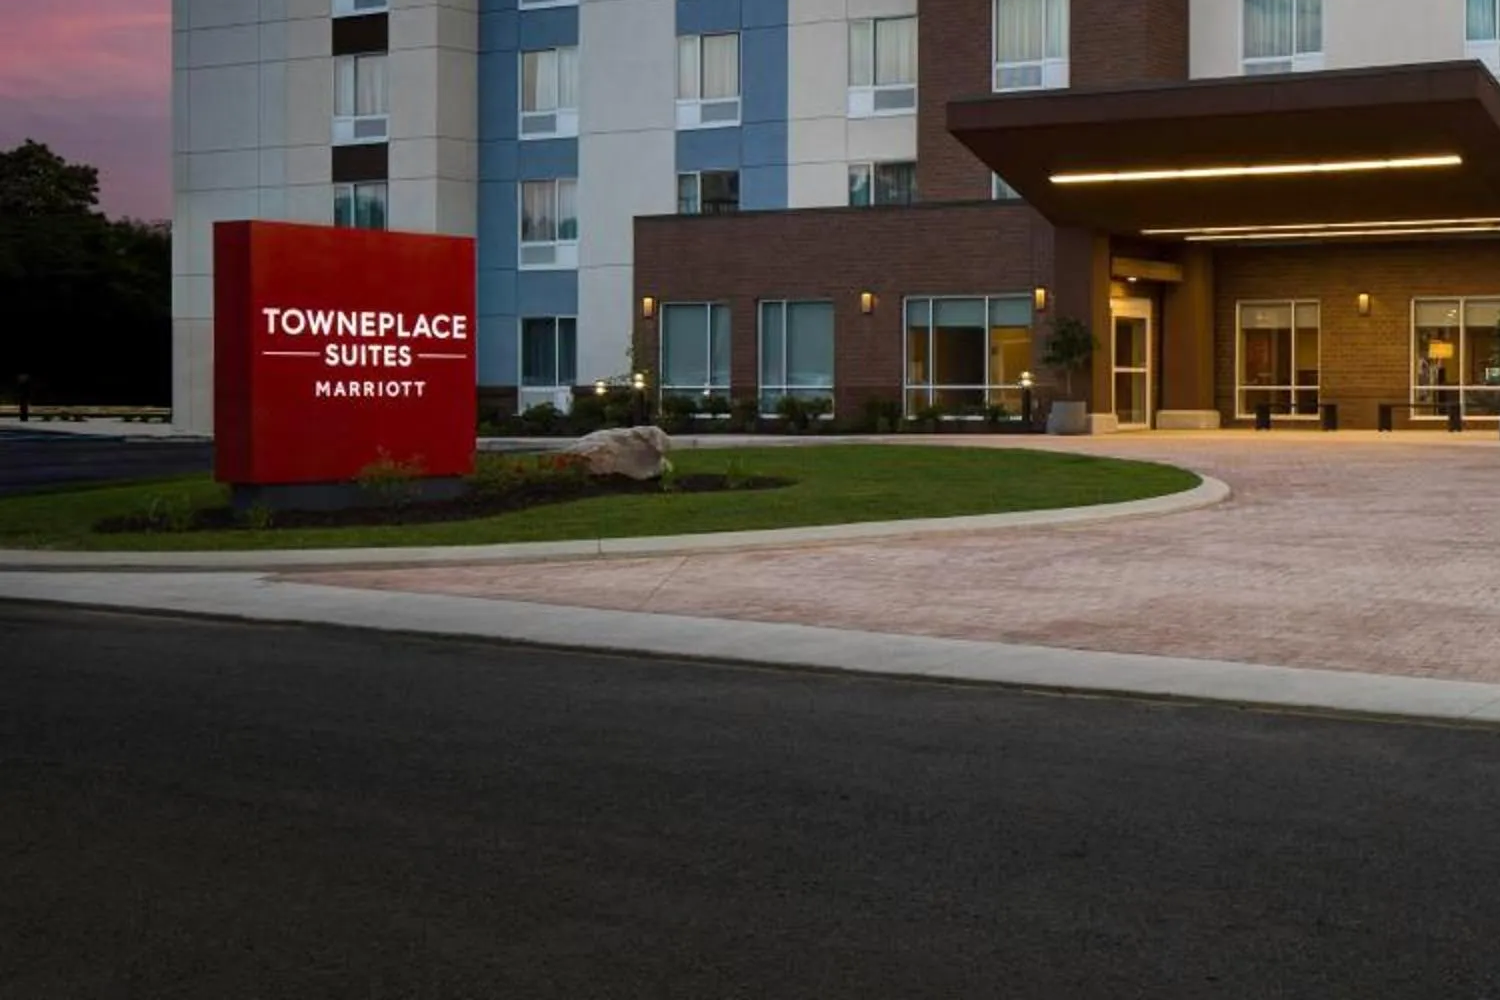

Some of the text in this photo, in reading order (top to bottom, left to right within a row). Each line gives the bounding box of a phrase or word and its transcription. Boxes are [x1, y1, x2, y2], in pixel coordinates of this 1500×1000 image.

[262, 307, 467, 340] TOWNEPLACE
[324, 343, 413, 368] SUITES
[315, 380, 427, 398] MARRIOTT
